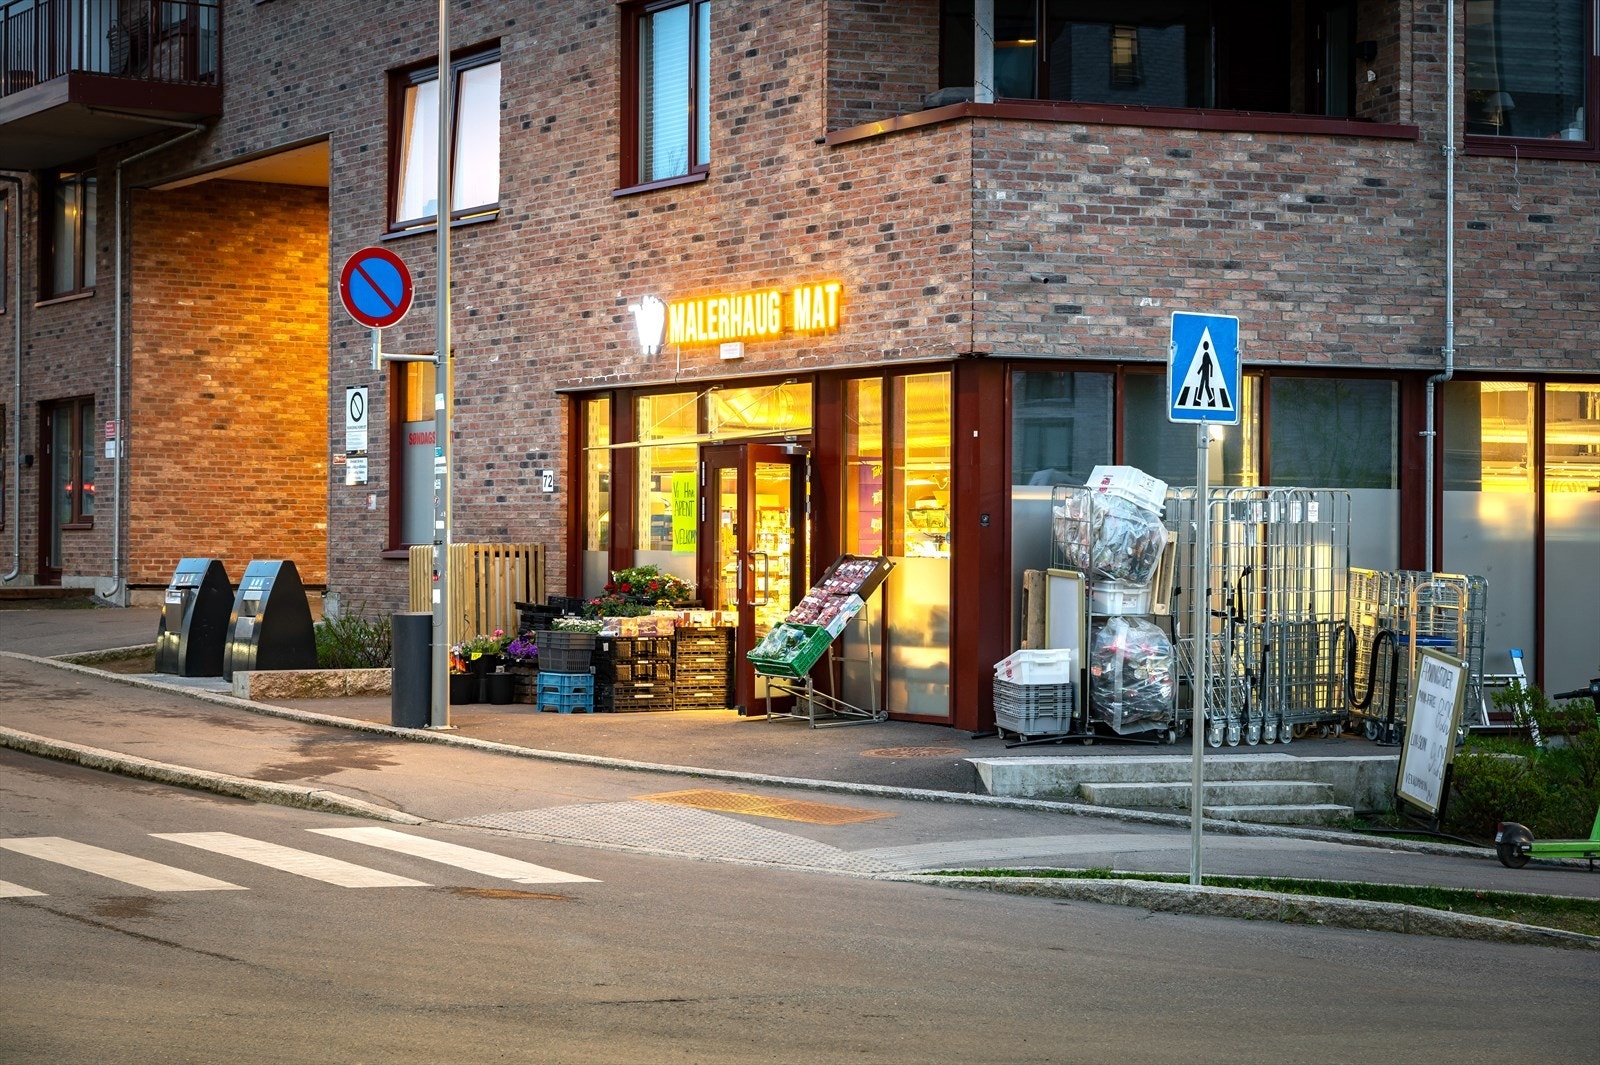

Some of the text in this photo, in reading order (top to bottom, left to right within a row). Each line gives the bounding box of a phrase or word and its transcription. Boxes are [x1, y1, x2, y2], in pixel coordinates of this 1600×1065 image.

[669, 283, 841, 343] MALERHAUG MAT
[543, 475, 552, 487] 72
